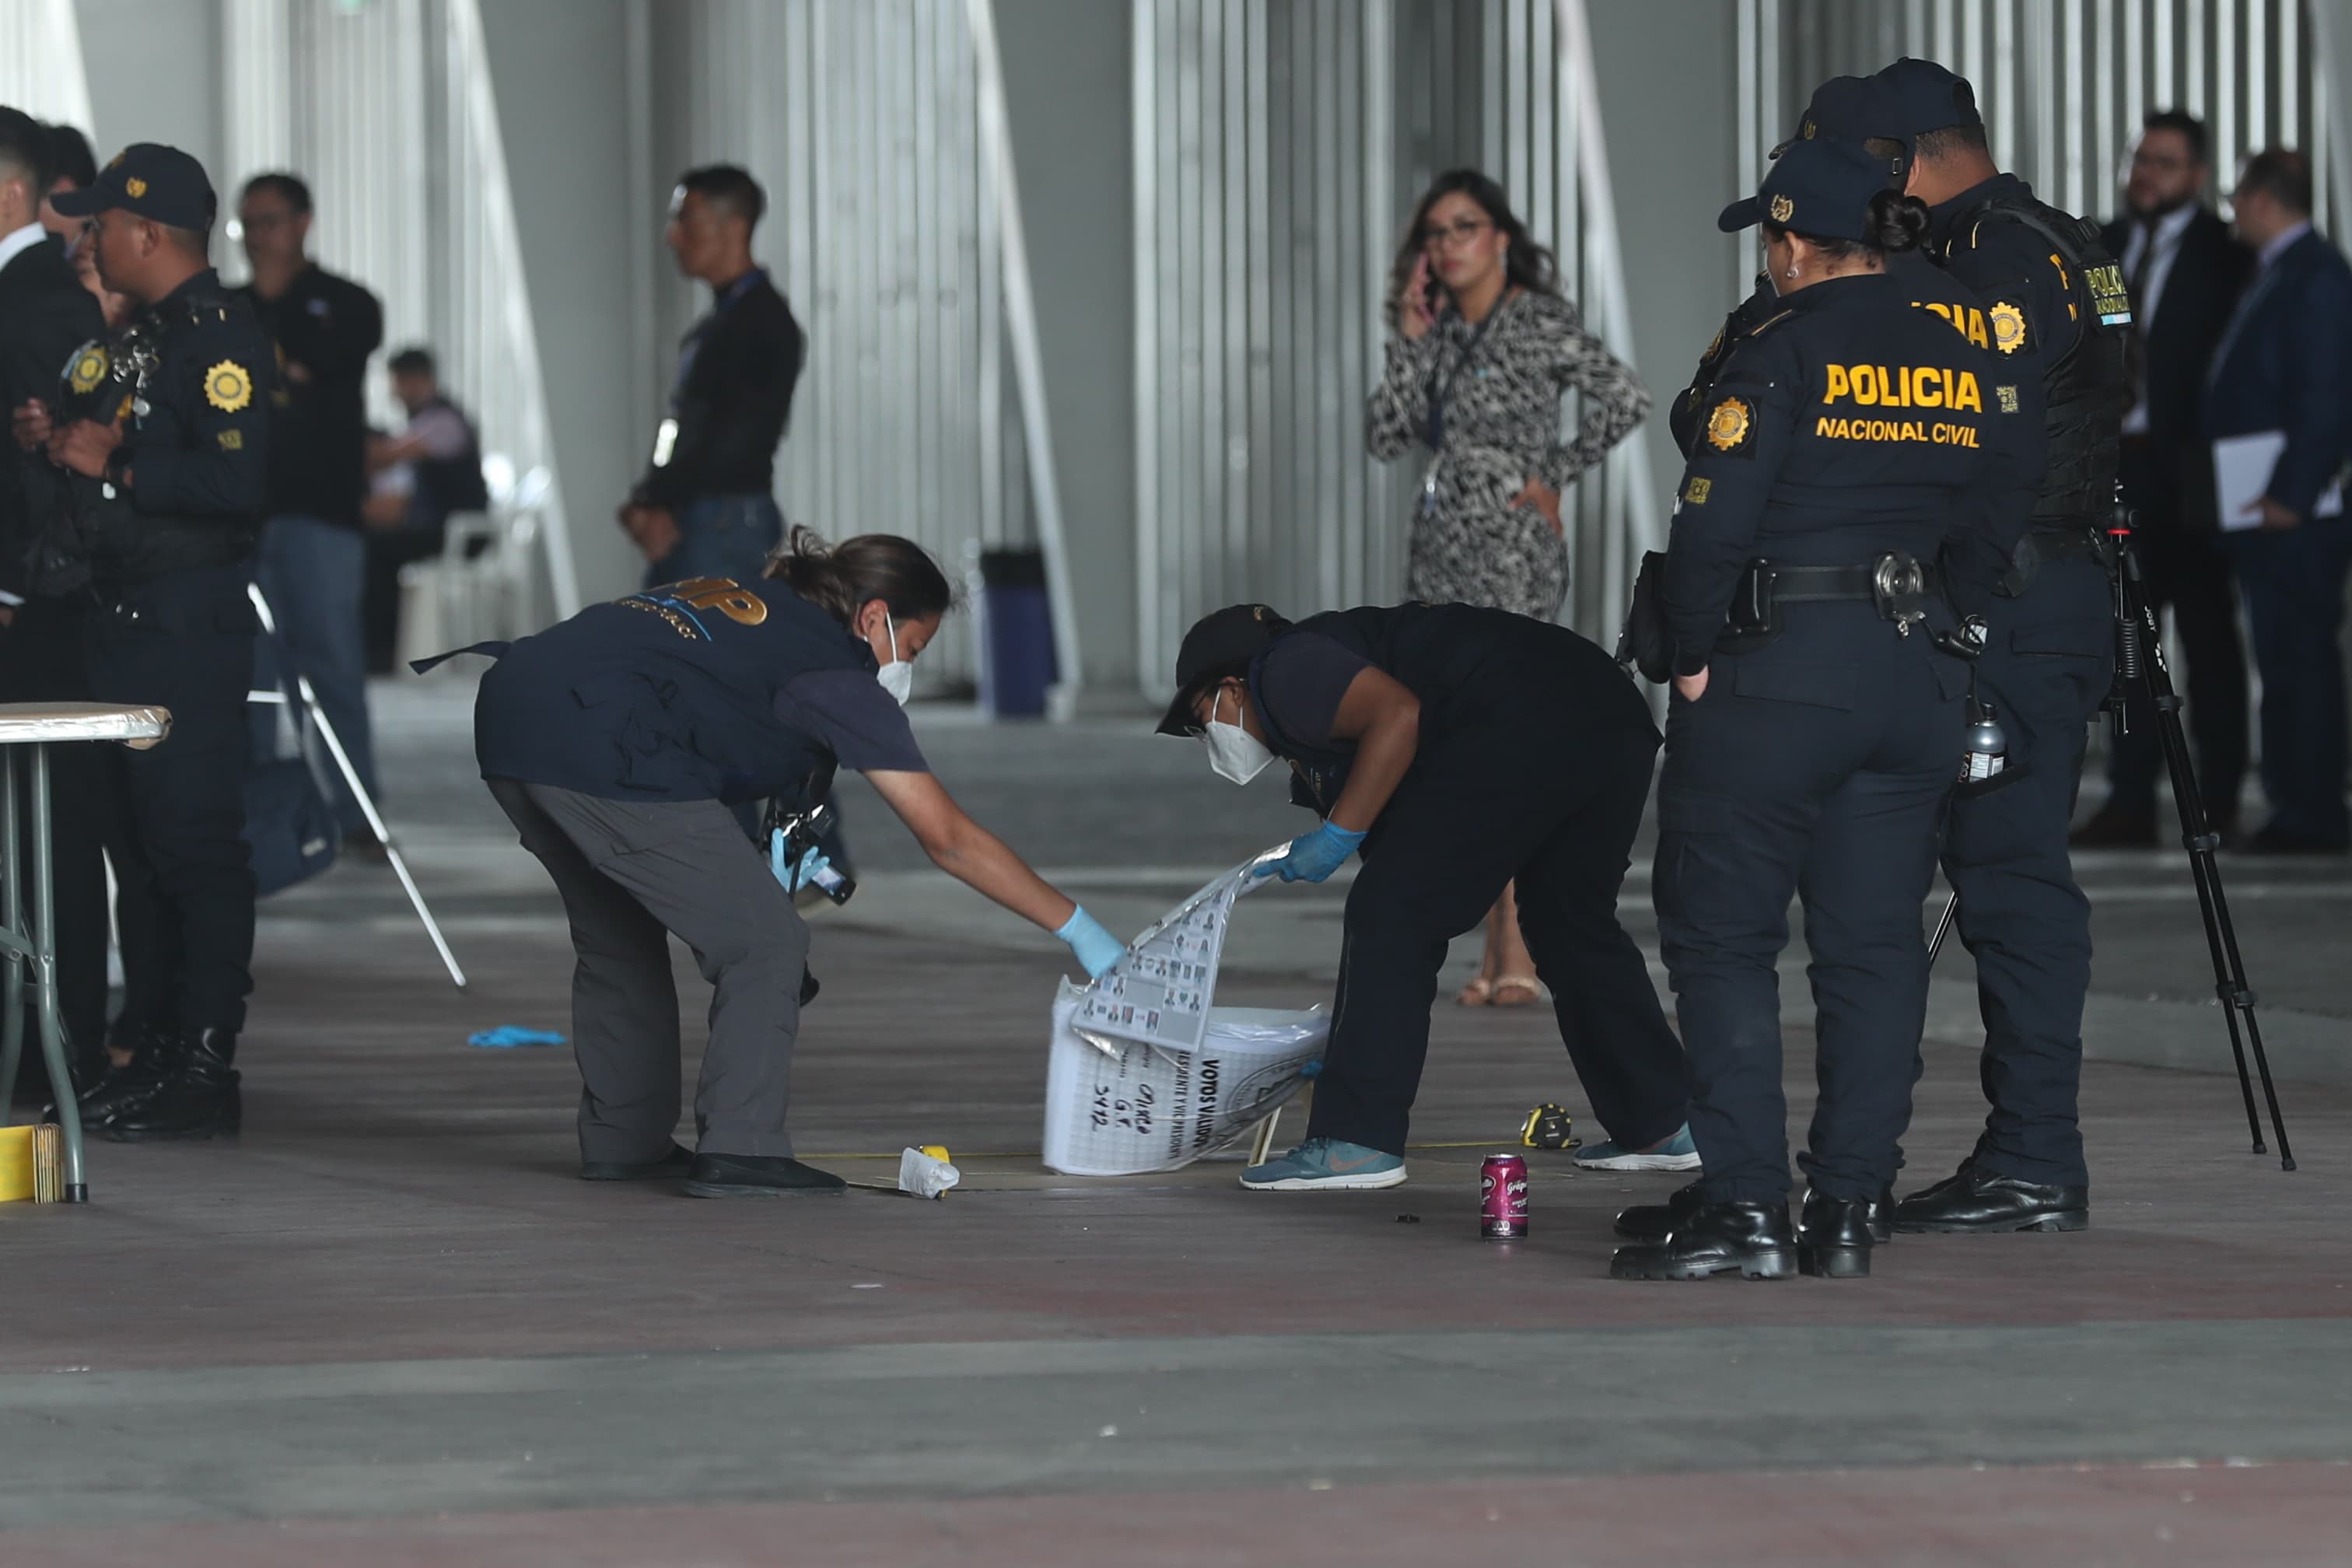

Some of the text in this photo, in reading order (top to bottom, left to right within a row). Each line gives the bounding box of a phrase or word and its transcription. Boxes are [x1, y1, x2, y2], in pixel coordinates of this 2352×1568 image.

[1823, 364, 1983, 414] POLICIA
[1816, 417, 1980, 449] NACIONAL CIVIL
[1199, 1059, 1220, 1103] VOTOS
